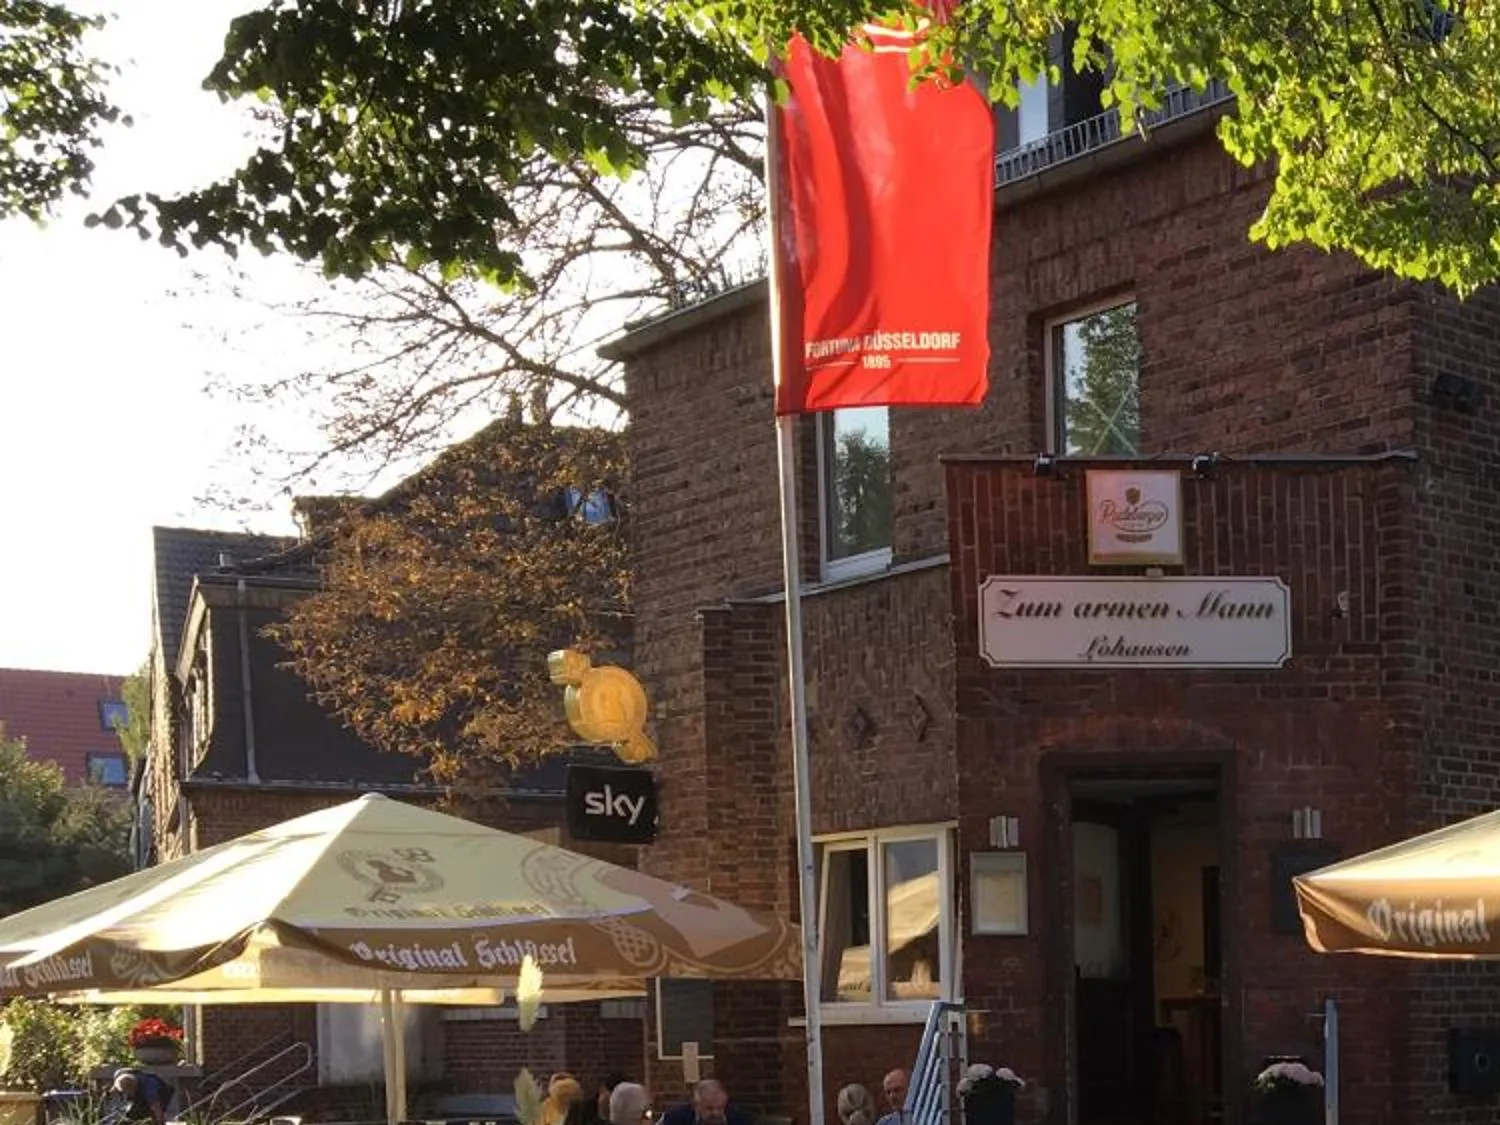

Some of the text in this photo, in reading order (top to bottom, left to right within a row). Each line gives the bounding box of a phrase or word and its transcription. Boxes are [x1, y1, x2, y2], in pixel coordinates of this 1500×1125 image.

[997, 589, 1274, 619] Zum armen Mann
[585, 784, 645, 825] sky
[1367, 899, 1491, 947] Original
[349, 940, 468, 970] Original
